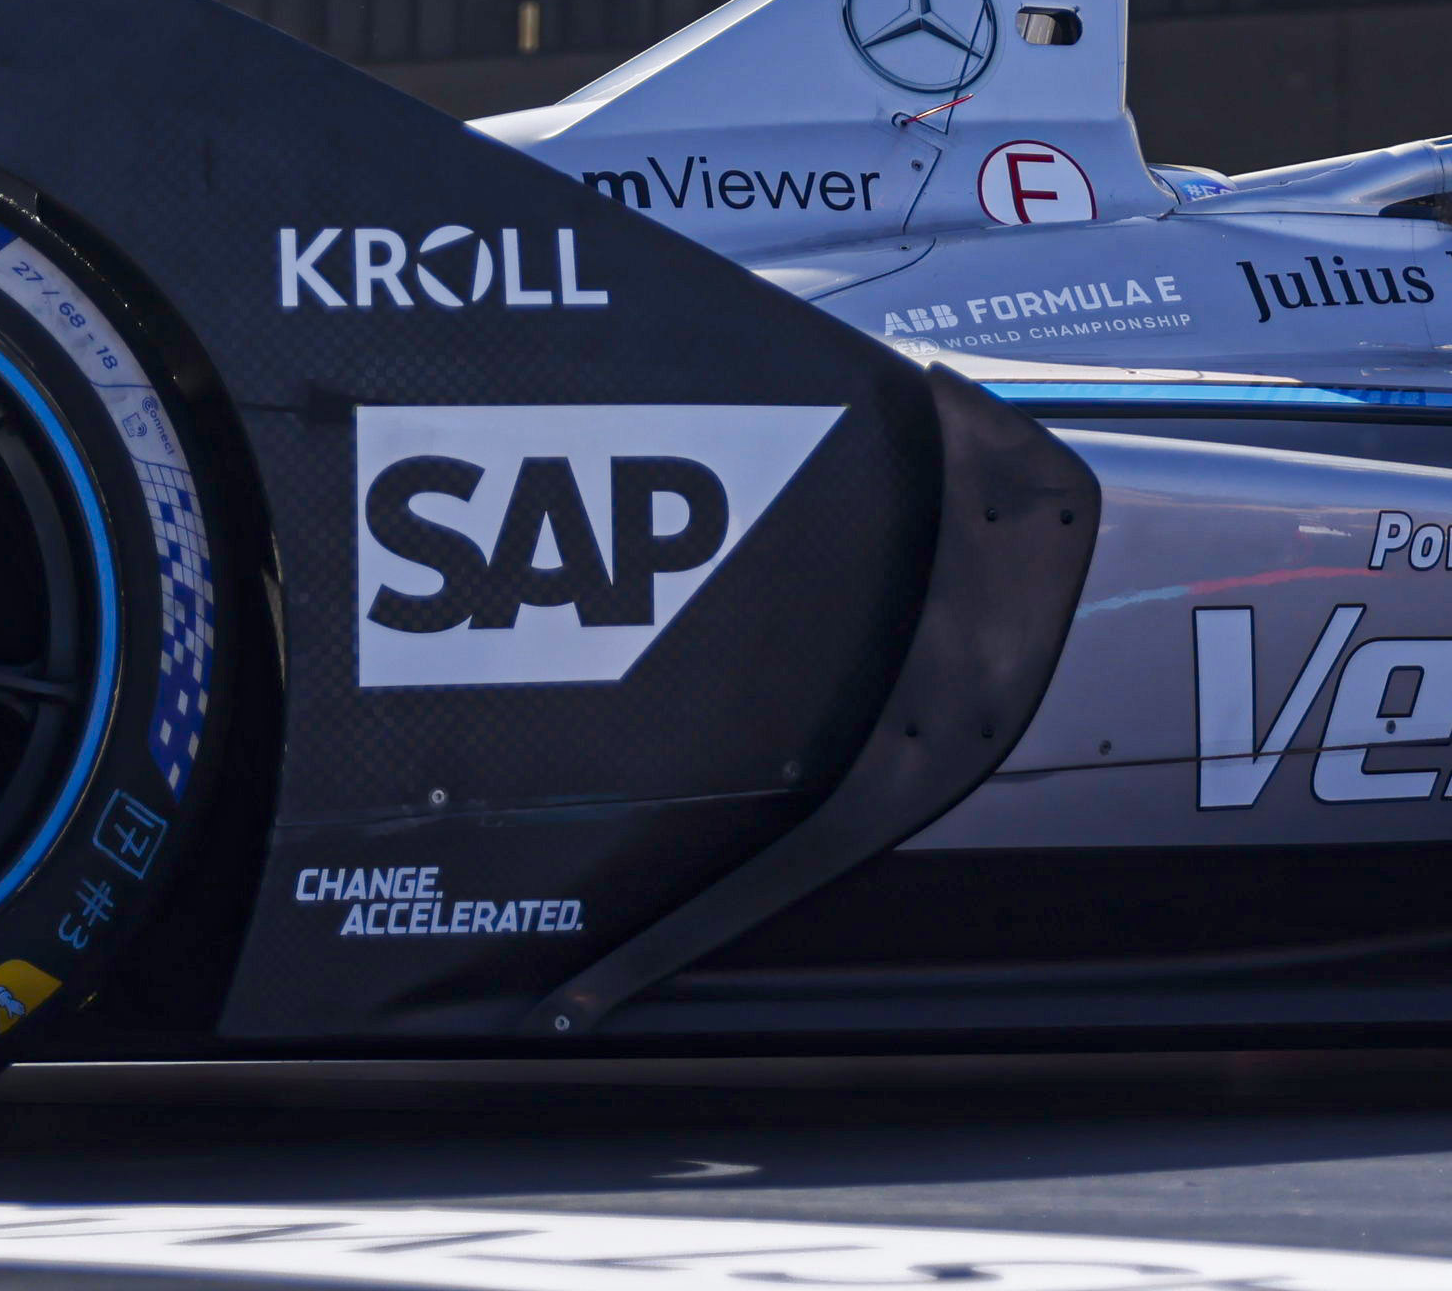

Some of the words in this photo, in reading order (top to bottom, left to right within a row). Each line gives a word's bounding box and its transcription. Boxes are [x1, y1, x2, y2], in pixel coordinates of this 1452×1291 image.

[278, 224, 609, 309] KROLL
[1236, 251, 1436, 324] Julius
[883, 303, 959, 337] ABB
[965, 279, 1153, 325] FORMULA
[1154, 275, 1183, 303] E
[944, 330, 1022, 350] WORLD
[1029, 312, 1192, 340] CHAMPIONSHIP
[363, 454, 731, 635] SAP
[294, 866, 445, 902] CHANGE.
[340, 898, 585, 937] ACCELERATED.
